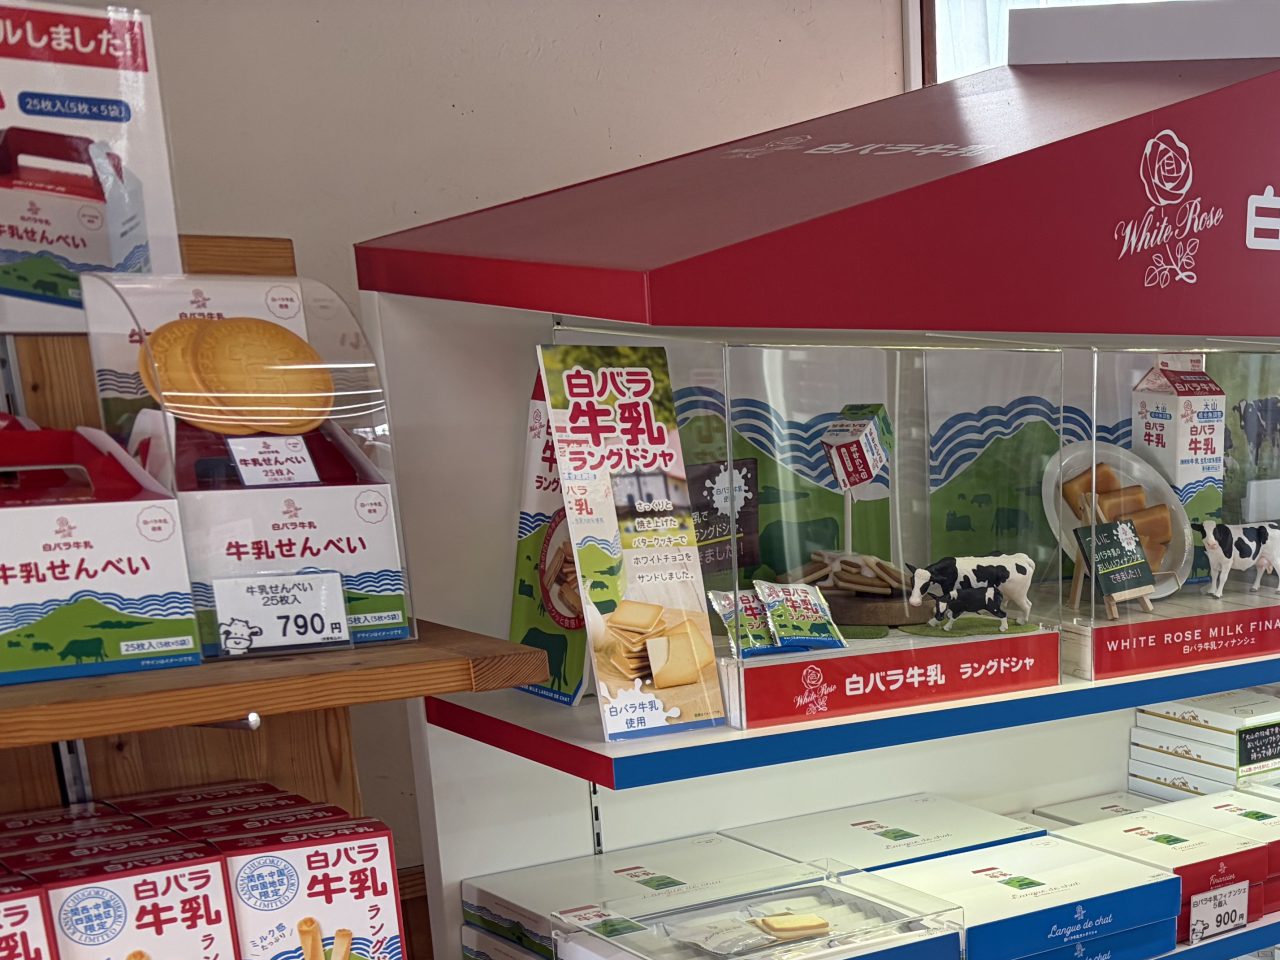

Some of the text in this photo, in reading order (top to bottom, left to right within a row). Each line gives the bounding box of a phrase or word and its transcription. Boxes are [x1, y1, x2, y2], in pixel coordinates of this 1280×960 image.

[1114, 196, 1224, 260] White Rose
[0, 225, 87, 250] 乳せんべい
[566, 369, 651, 398] 白バラ
[1203, 401, 1218, 410] 大山
[569, 400, 665, 447] 牛乳
[1188, 438, 1216, 455] 牛乳
[239, 456, 307, 467] 牛乳せんべい
[569, 449, 674, 472] ラングドシャ
[262, 468, 295, 477] 25枚入
[636, 500, 674, 511] さっくりと
[636, 517, 678, 530] 焼き上げた
[225, 536, 367, 561] 牛乳せんべい
[633, 536, 687, 548] バタークッキーで
[633, 553, 692, 565] ホワイトチョコを
[0, 554, 151, 586] 牛乳せんべい
[637, 571, 694, 583] サンドしました。
[246, 582, 314, 596] 牛乳せんべい
[262, 594, 302, 606] 25枚入
[276, 613, 342, 637] 790 円
[1106, 635, 1157, 653] WHITE
[1163, 629, 1203, 645] ROSE
[1208, 622, 1245, 638] MILK
[1183, 637, 1256, 655] 白バラ牛乳フィナンシェ
[845, 657, 1036, 697] 白バラ牛乳 ラングドシャ
[608, 699, 659, 716] 白バラ牛乳
[625, 715, 647, 729] 使用
[306, 843, 379, 871] 白バラ
[134, 870, 212, 899] 白バラ
[246, 868, 287, 883] 関西・中国
[251, 878, 287, 892] 四国地区
[258, 888, 282, 900] 限定
[306, 867, 388, 904] 牛乳
[70, 899, 112, 917] 関西・中国
[253, 895, 291, 909] LIMITED
[74, 909, 114, 925] 四国地区
[136, 895, 223, 936] 牛乳
[1215, 909, 1244, 928] 900 円
[83, 919, 109, 934] 限定
[250, 922, 287, 948] ミルク感
[1048, 914, 1113, 939] Langue de chat
[261, 933, 287, 951] たっぷり
